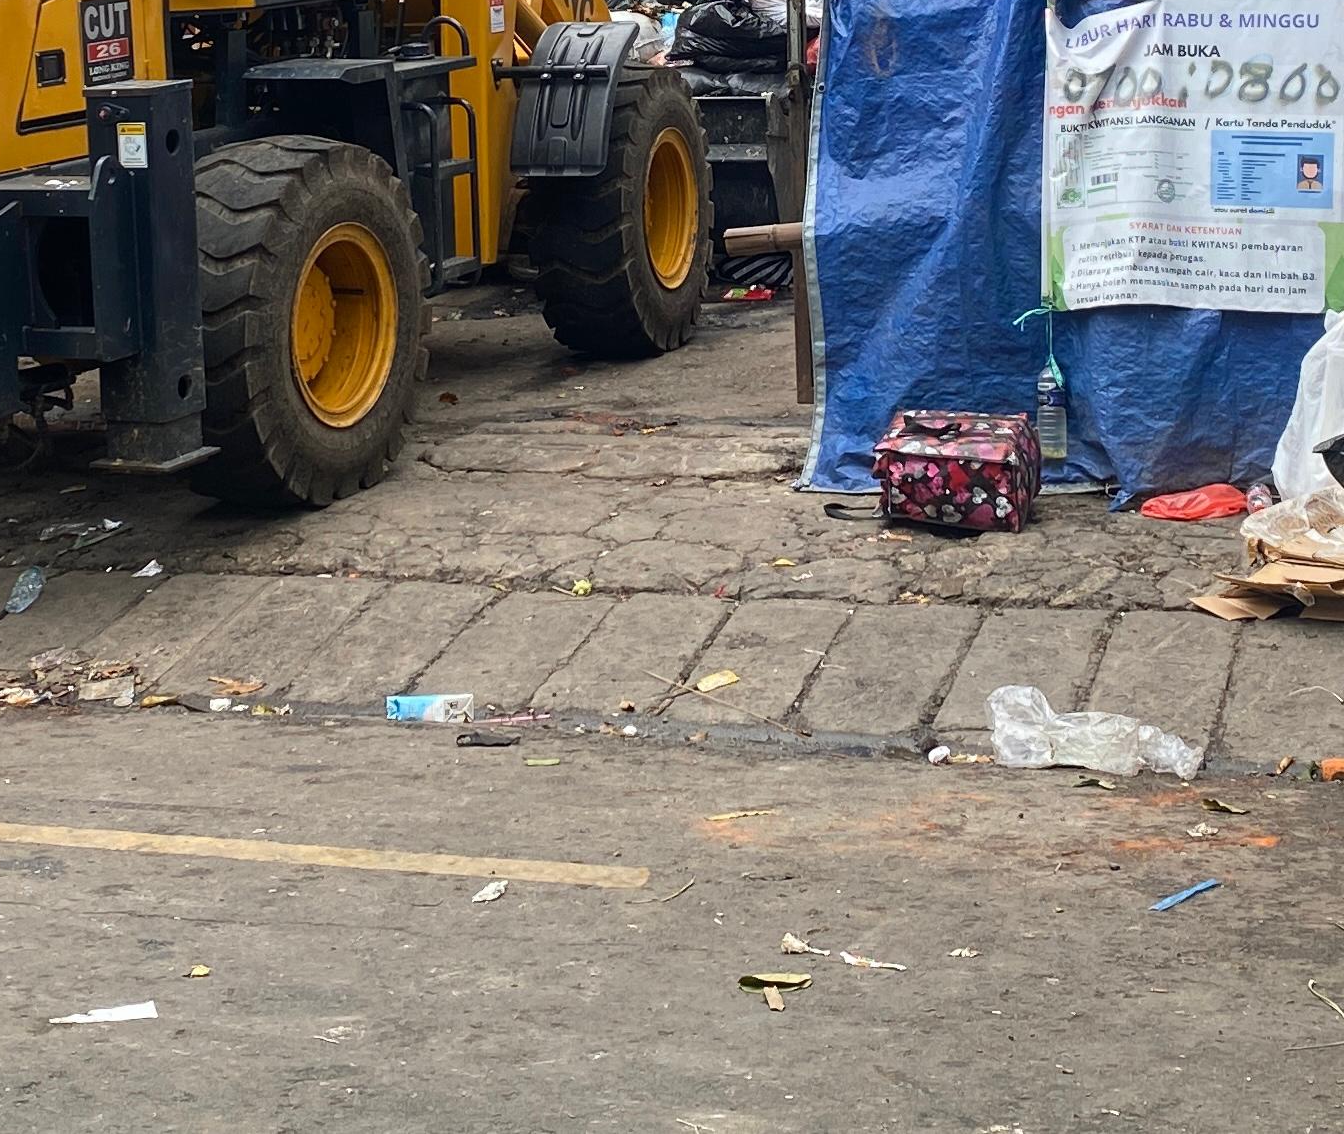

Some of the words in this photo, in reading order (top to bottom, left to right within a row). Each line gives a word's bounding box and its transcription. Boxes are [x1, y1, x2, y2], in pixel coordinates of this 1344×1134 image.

[84, 1, 129, 41] CUT
[1066, 23, 1112, 49] LIBUR
[1116, 12, 1156, 34] HARI
[1163, 13, 1213, 28] RABU
[1218, 13, 1233, 28] &
[1239, 13, 1320, 29] MINGGU
[96, 42, 121, 58] 26
[1143, 43, 1174, 58] JAM
[1177, 44, 1221, 58] BUKA
[1086, 116, 1134, 131] KWITANSI
[1135, 115, 1196, 127] LANGGANAN
[1204, 117, 1211, 130] /
[1215, 117, 1245, 128] Kartu
[1246, 118, 1279, 128] Tanda
[1129, 222, 1164, 230] SYARAT
[1166, 224, 1182, 233] DAN
[1184, 226, 1242, 235] KETENTUAN
[1128, 235, 1146, 244] KTP
[1148, 236, 1167, 245] atau
[1191, 240, 1238, 250] KWITANSI
[1241, 242, 1304, 253] pembayaran
[1138, 249, 1168, 261] kepada
[1112, 262, 1160, 274] membuang
[1161, 266, 1193, 277] sampah
[1219, 268, 1241, 278] kaca
[1243, 270, 1262, 279] dan
[1264, 270, 1299, 281] limbah
[1180, 282, 1216, 293] sampah
[1218, 284, 1242, 294] pada
[1244, 284, 1264, 294] hari
[1267, 285, 1286, 295] dan
[1288, 285, 1307, 296] jam
